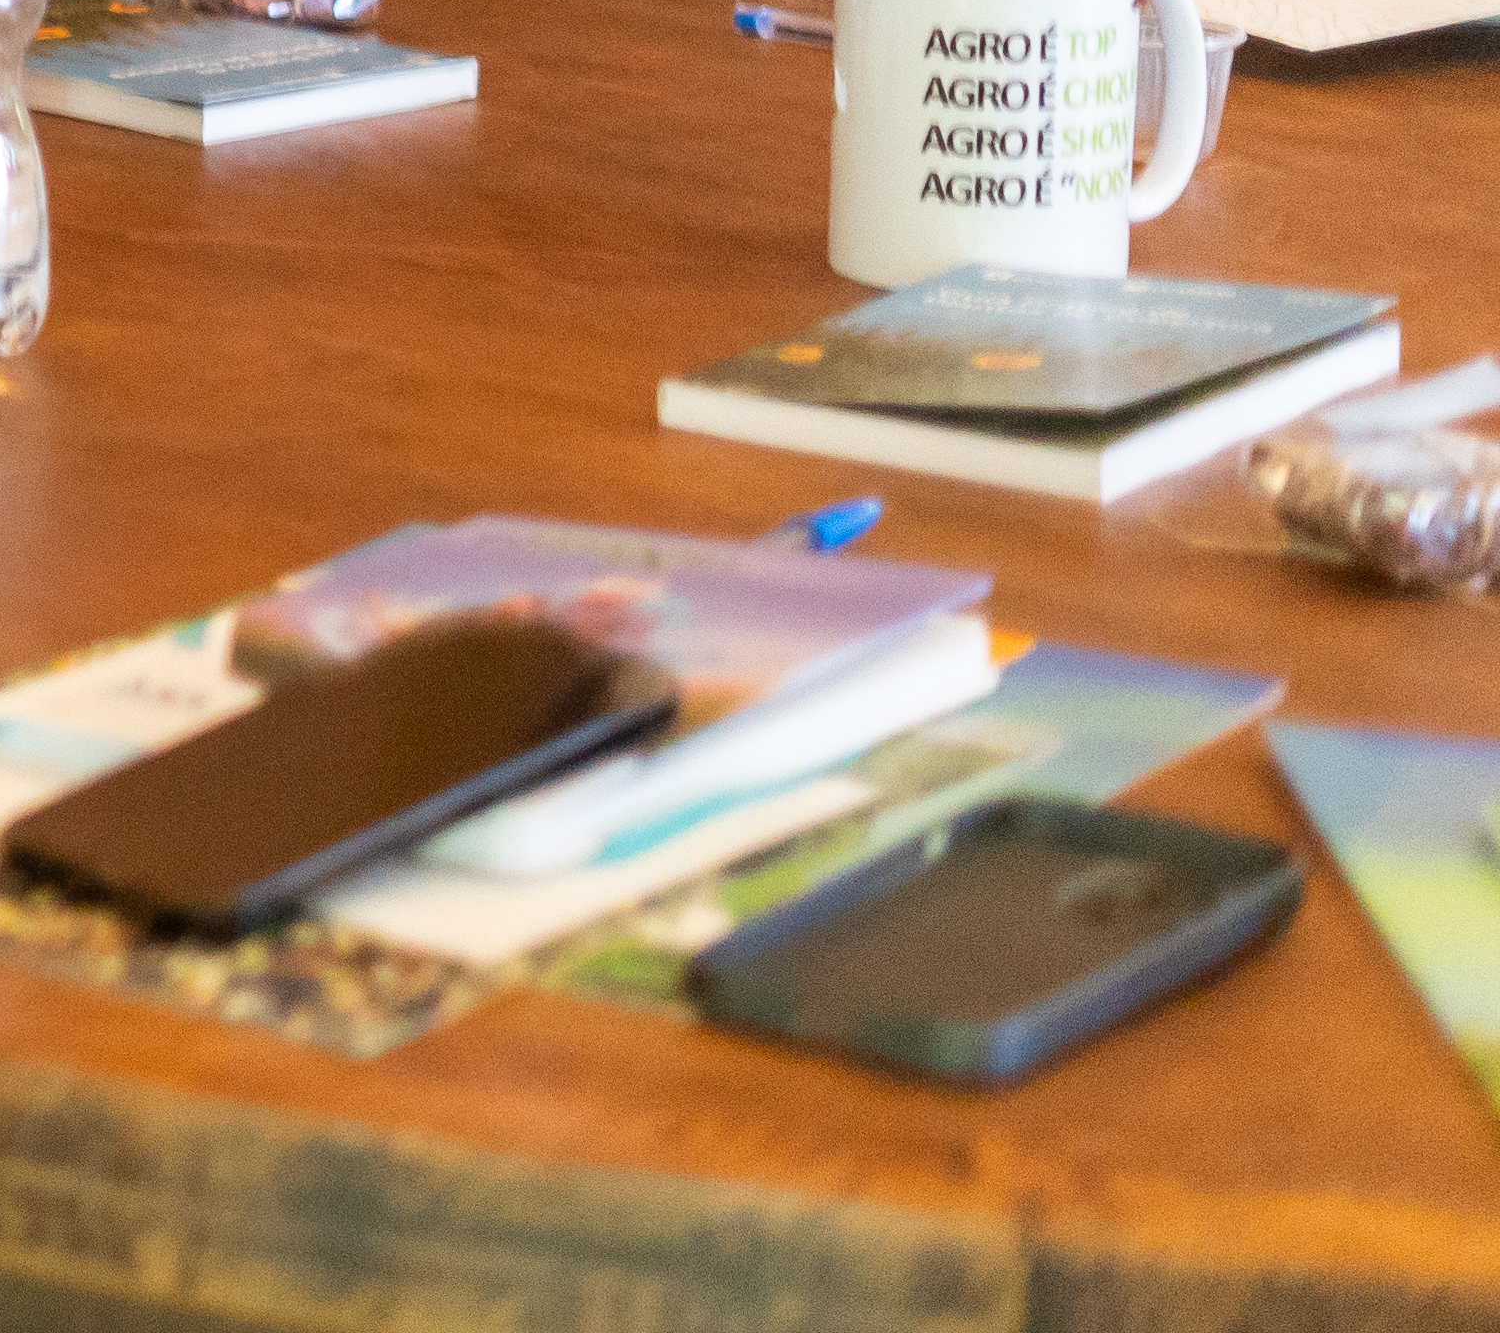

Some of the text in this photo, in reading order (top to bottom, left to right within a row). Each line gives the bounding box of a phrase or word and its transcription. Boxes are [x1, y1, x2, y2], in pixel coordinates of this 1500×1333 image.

[924, 19, 1118, 64] AGRO É TOP
[922, 73, 1030, 112] AGRO
[1038, 70, 1056, 113] É
[921, 116, 1131, 161] AGRO É SHOW
[920, 169, 1027, 208] AGRO
[1035, 165, 1053, 209] É
